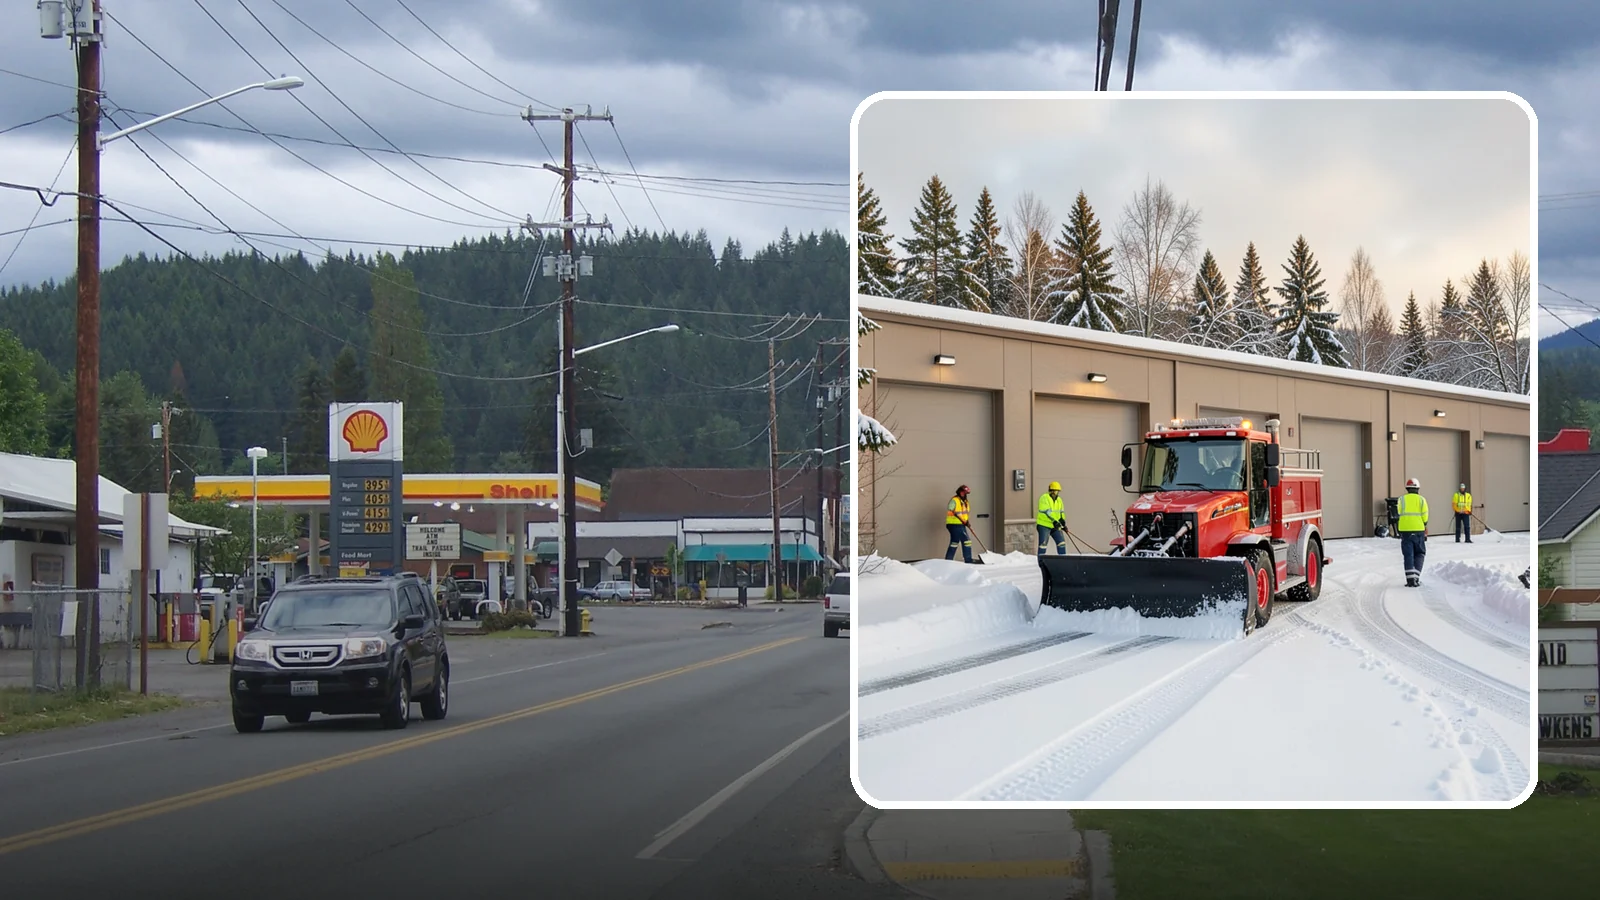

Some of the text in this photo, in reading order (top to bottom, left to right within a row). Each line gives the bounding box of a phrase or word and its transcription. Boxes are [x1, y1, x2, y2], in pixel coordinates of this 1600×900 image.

[365, 480, 383, 490] 395
[490, 484, 547, 499] Shell
[365, 494, 383, 504] 405
[365, 508, 383, 518] 415
[365, 522, 383, 533] 429
